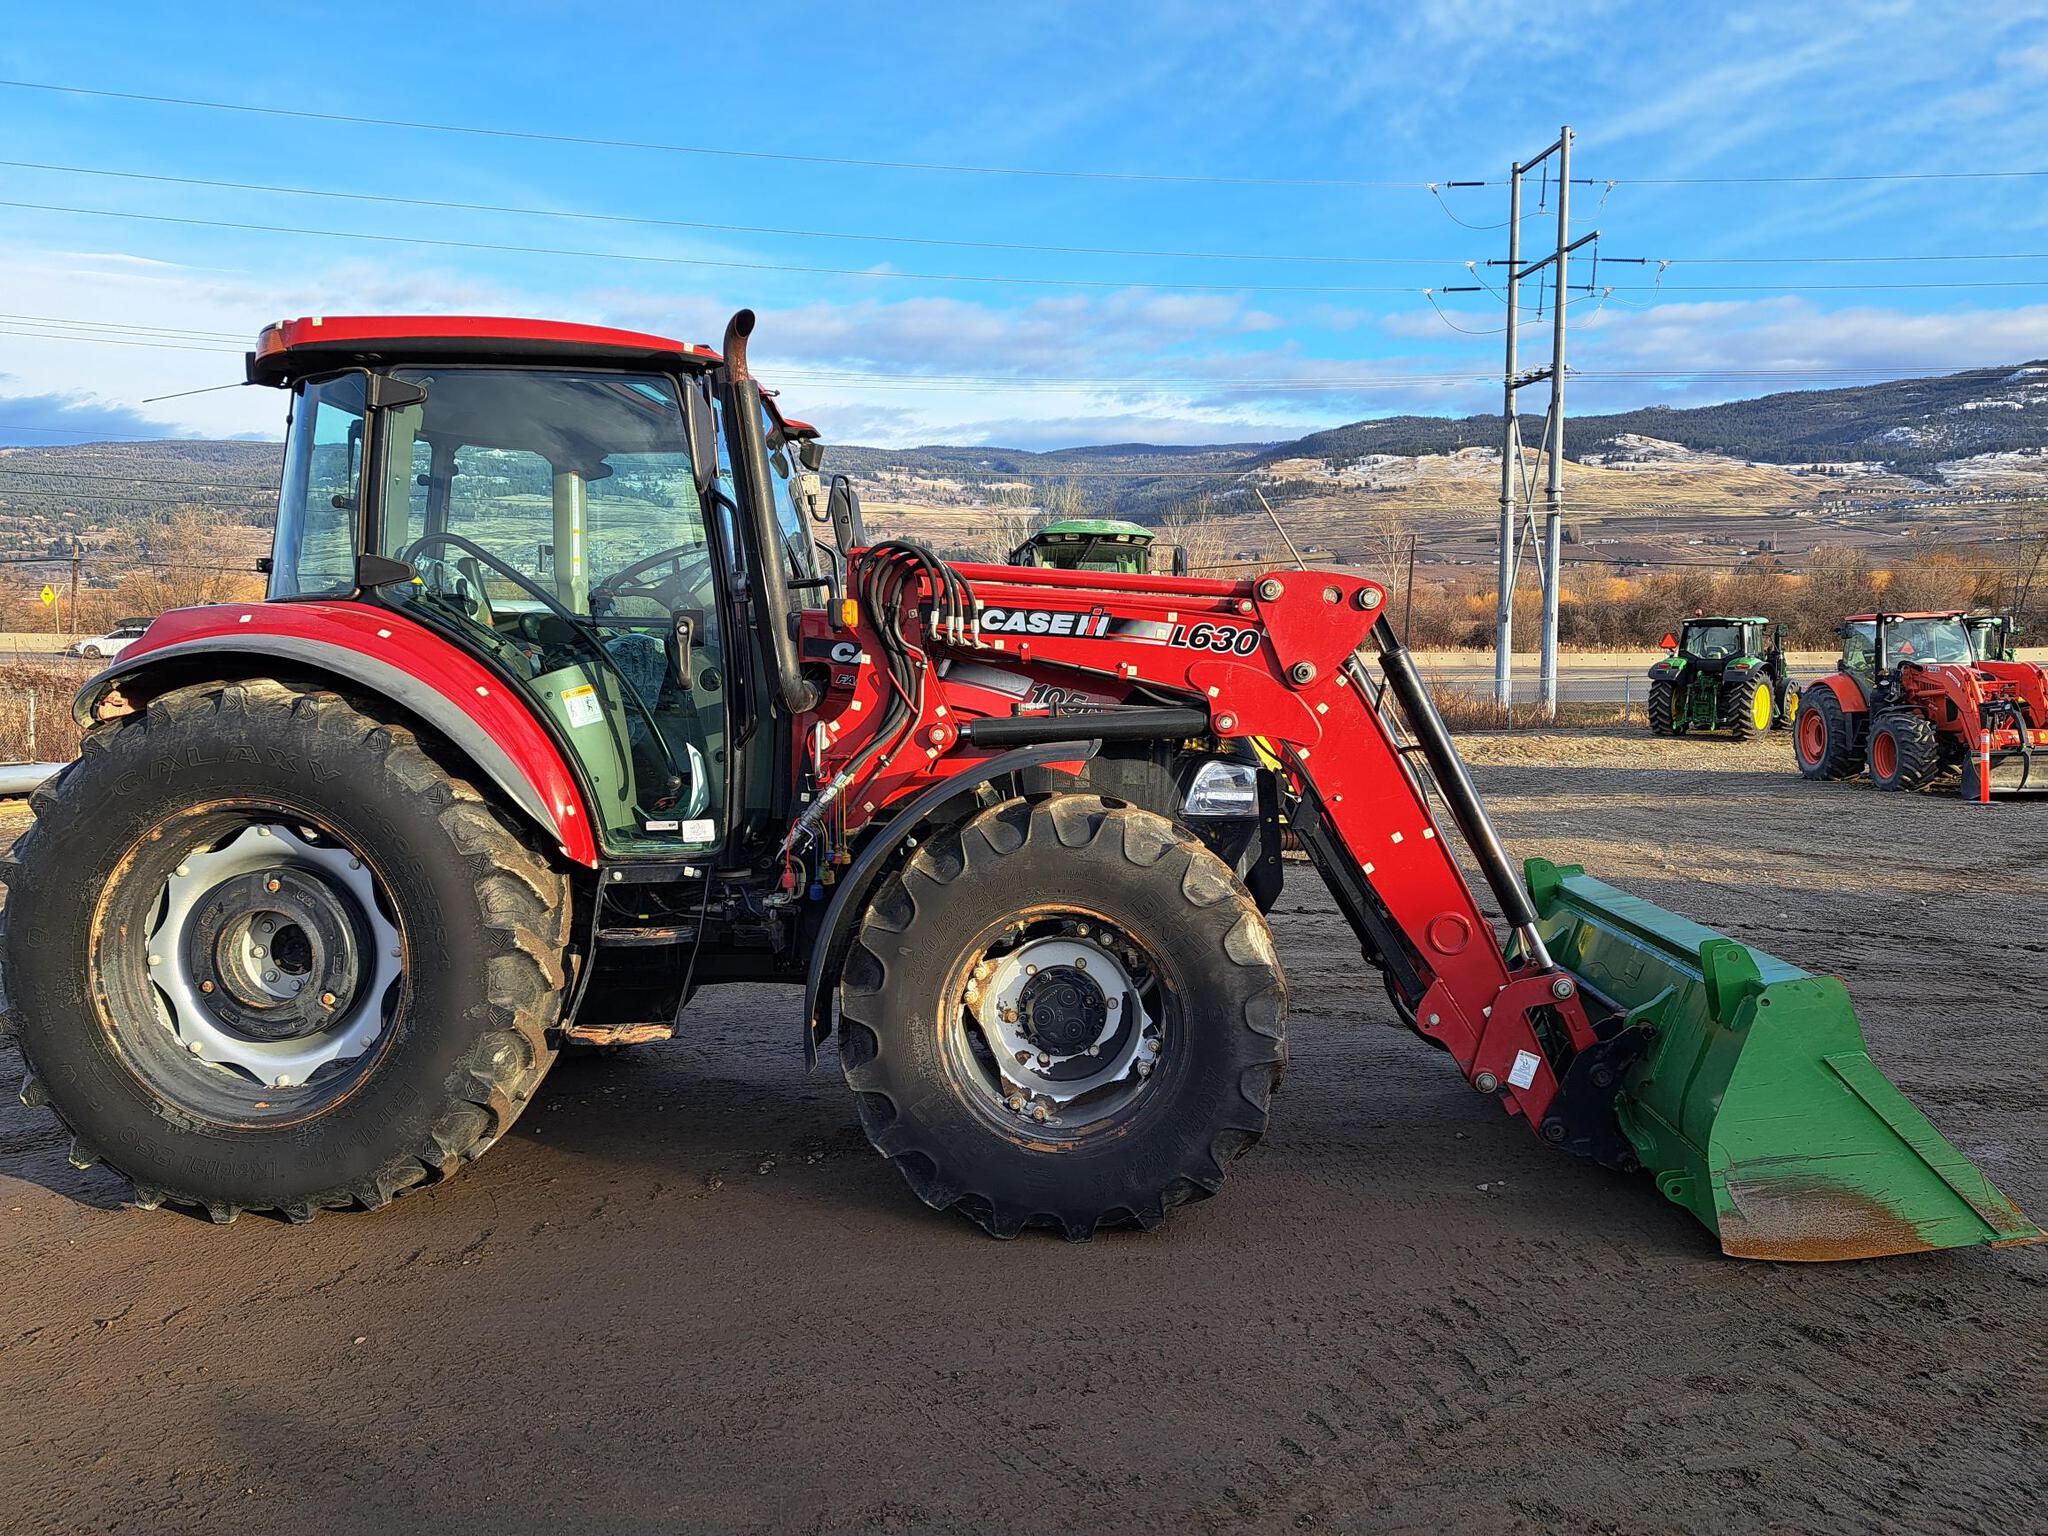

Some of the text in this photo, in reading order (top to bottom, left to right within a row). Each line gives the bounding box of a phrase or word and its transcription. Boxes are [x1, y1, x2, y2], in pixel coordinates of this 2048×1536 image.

[980, 609, 1077, 635] CASE
[1168, 622, 1261, 657] L630
[112, 745, 342, 797] GALAXY
